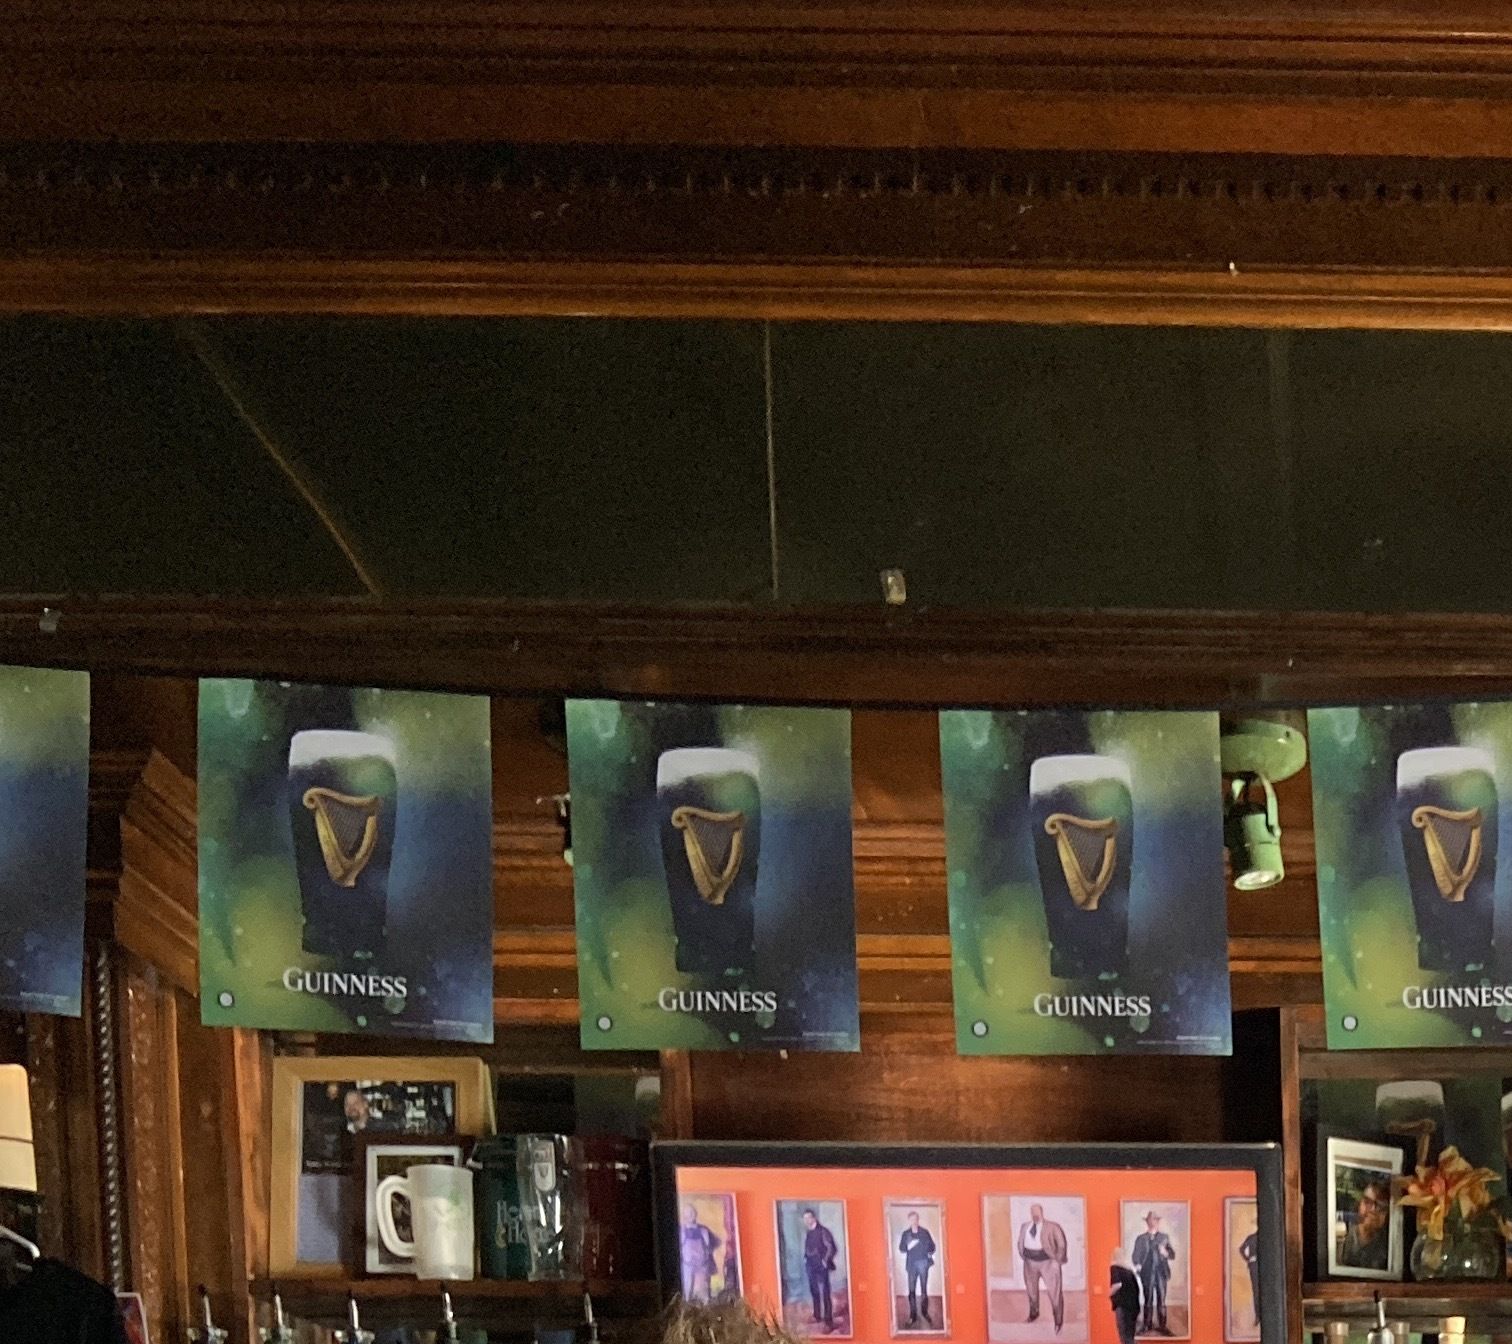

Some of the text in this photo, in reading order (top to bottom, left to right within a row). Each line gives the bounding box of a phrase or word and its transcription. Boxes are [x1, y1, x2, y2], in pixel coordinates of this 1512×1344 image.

[283, 967, 408, 999] GUINNESS
[659, 987, 778, 1013] GUINNESS
[1033, 992, 1151, 1018] GUINNESS
